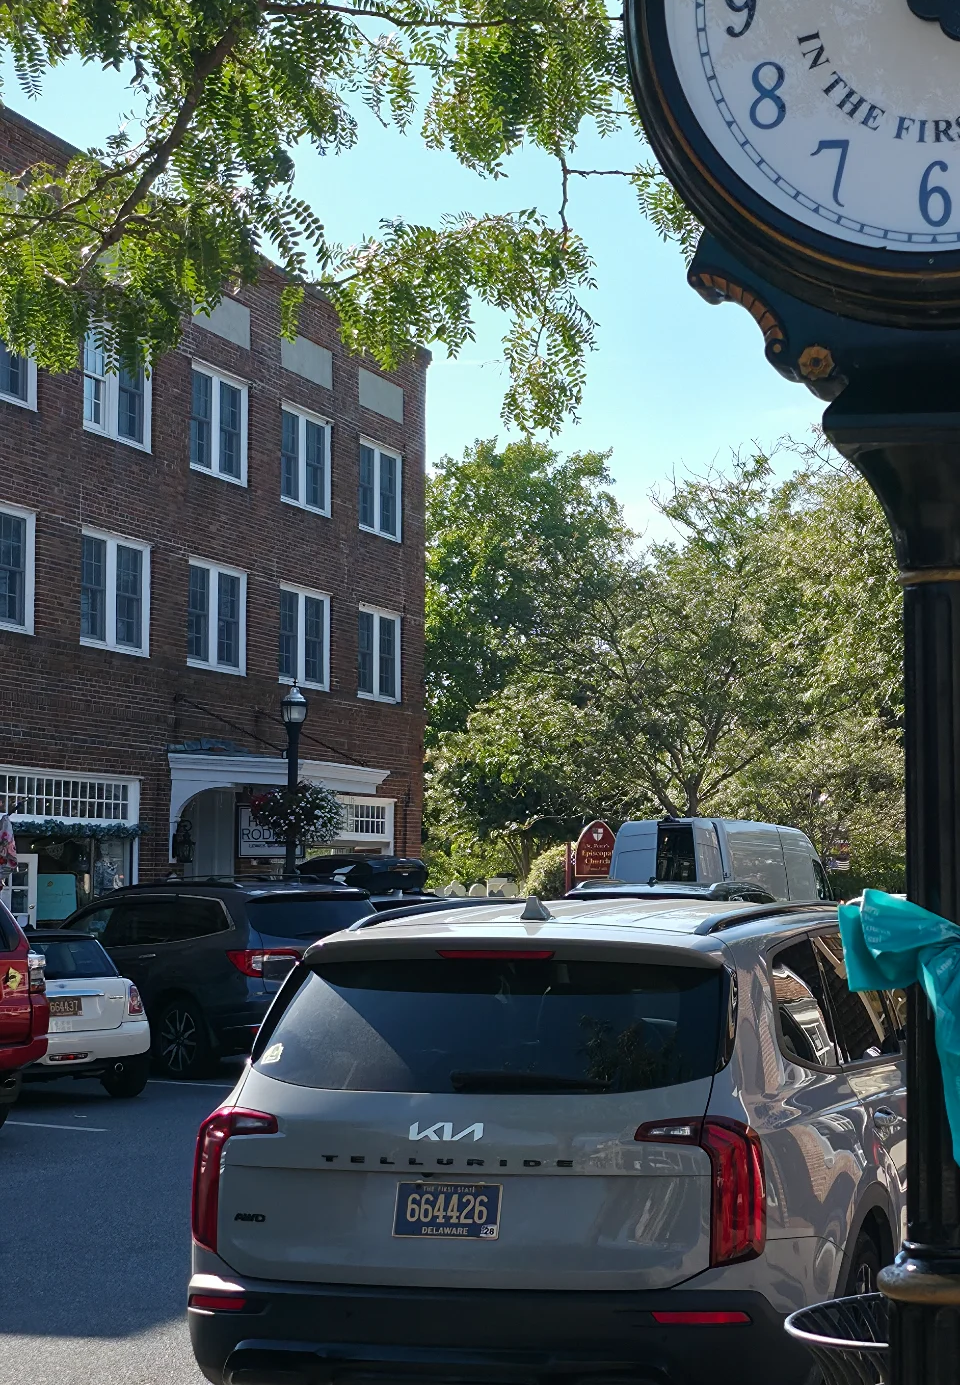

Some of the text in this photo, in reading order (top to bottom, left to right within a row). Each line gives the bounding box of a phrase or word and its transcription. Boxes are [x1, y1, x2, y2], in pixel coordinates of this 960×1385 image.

[749, 61, 787, 130] 8
[797, 30, 831, 70] IN
[821, 70, 886, 131] THE
[809, 139, 850, 208] 7
[918, 160, 953, 228] 6
[408, 1121, 484, 1142] KIA
[321, 1154, 574, 1167] TELLURIDE
[234, 1213, 266, 1223] AWD
[406, 1193, 489, 1224] 664426
[421, 1226, 469, 1235] DELAWARE
